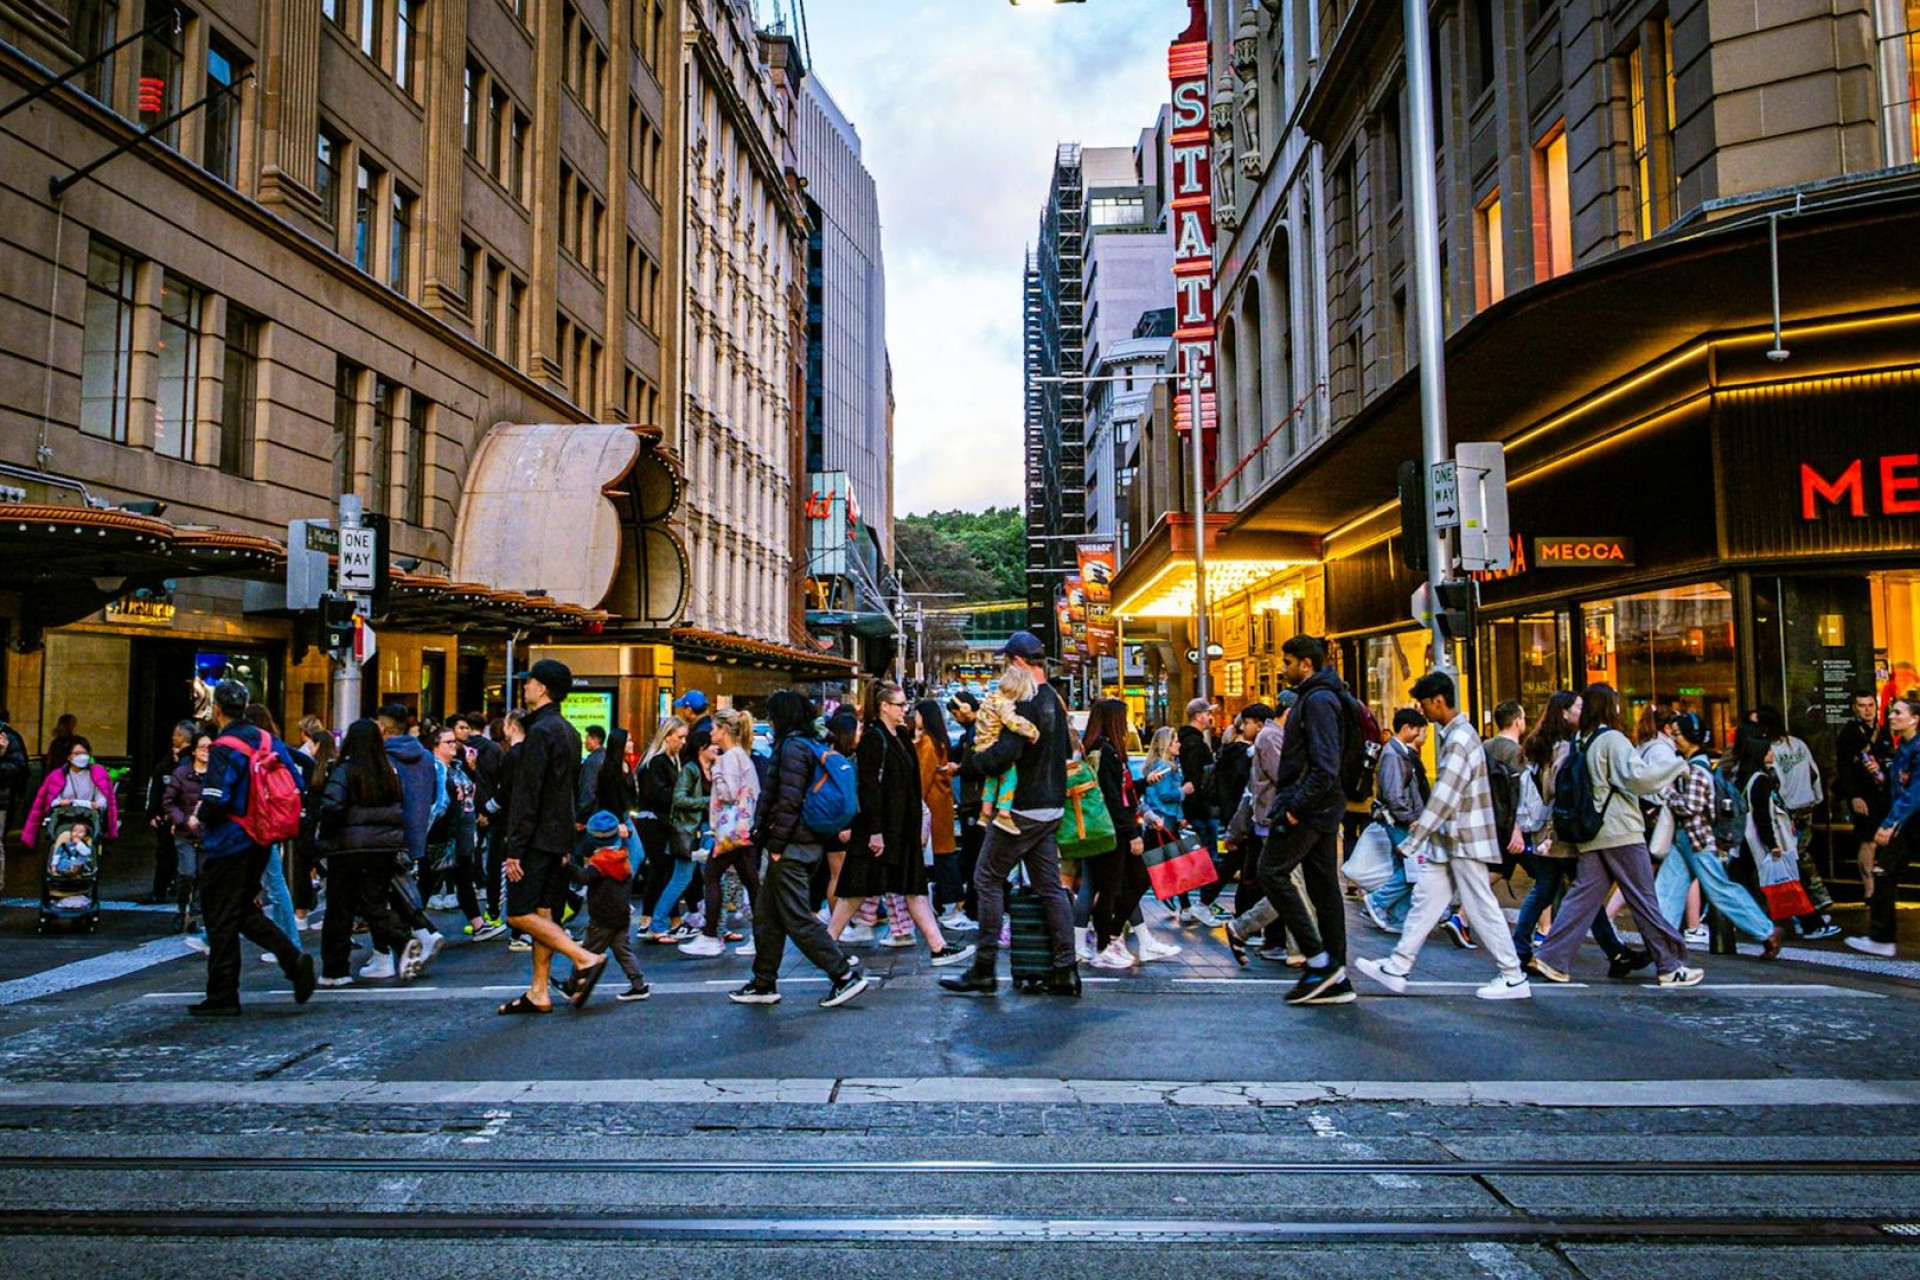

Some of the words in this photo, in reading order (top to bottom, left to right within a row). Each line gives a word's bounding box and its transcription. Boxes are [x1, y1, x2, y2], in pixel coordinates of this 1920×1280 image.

[1173, 80, 1212, 390] STATE
[1435, 467, 1453, 484] ONE
[1435, 489, 1456, 503] WAY
[345, 533, 369, 548] ONE
[343, 552, 370, 566] WAY
[1541, 543, 1625, 560] MECCA
